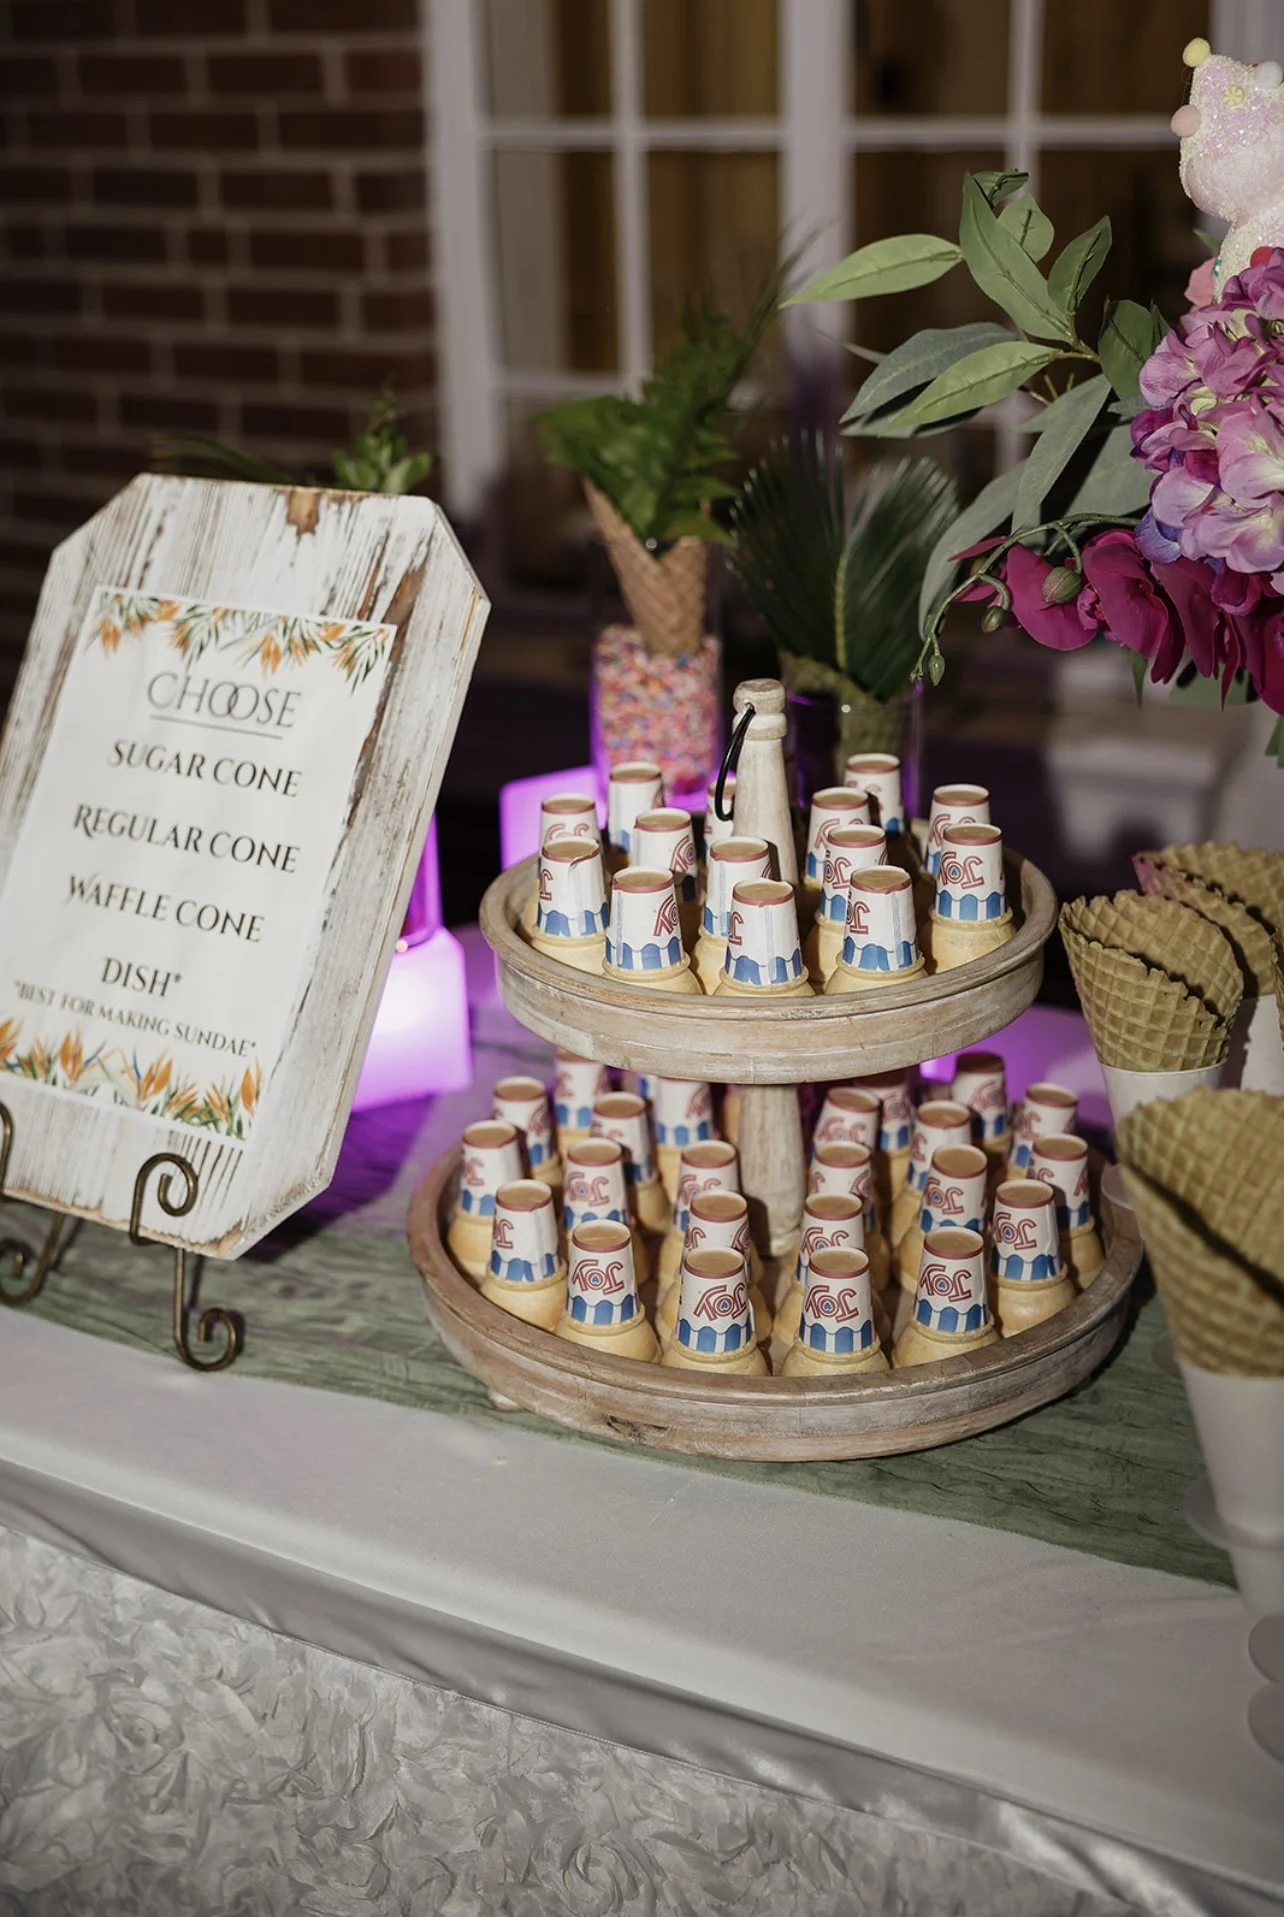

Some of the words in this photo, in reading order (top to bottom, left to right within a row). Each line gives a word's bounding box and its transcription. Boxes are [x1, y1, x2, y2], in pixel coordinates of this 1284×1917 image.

[147, 671, 302, 728] CHOOSE
[107, 739, 206, 779] SUGAR
[213, 757, 303, 797] CONE
[73, 803, 202, 853] REGULAR
[210, 832, 300, 874] CONE
[65, 871, 171, 921] WAFFLE
[176, 899, 265, 943] CONE
[61, 993, 97, 1017] FOR
[99, 1005, 171, 1036] MAKING
